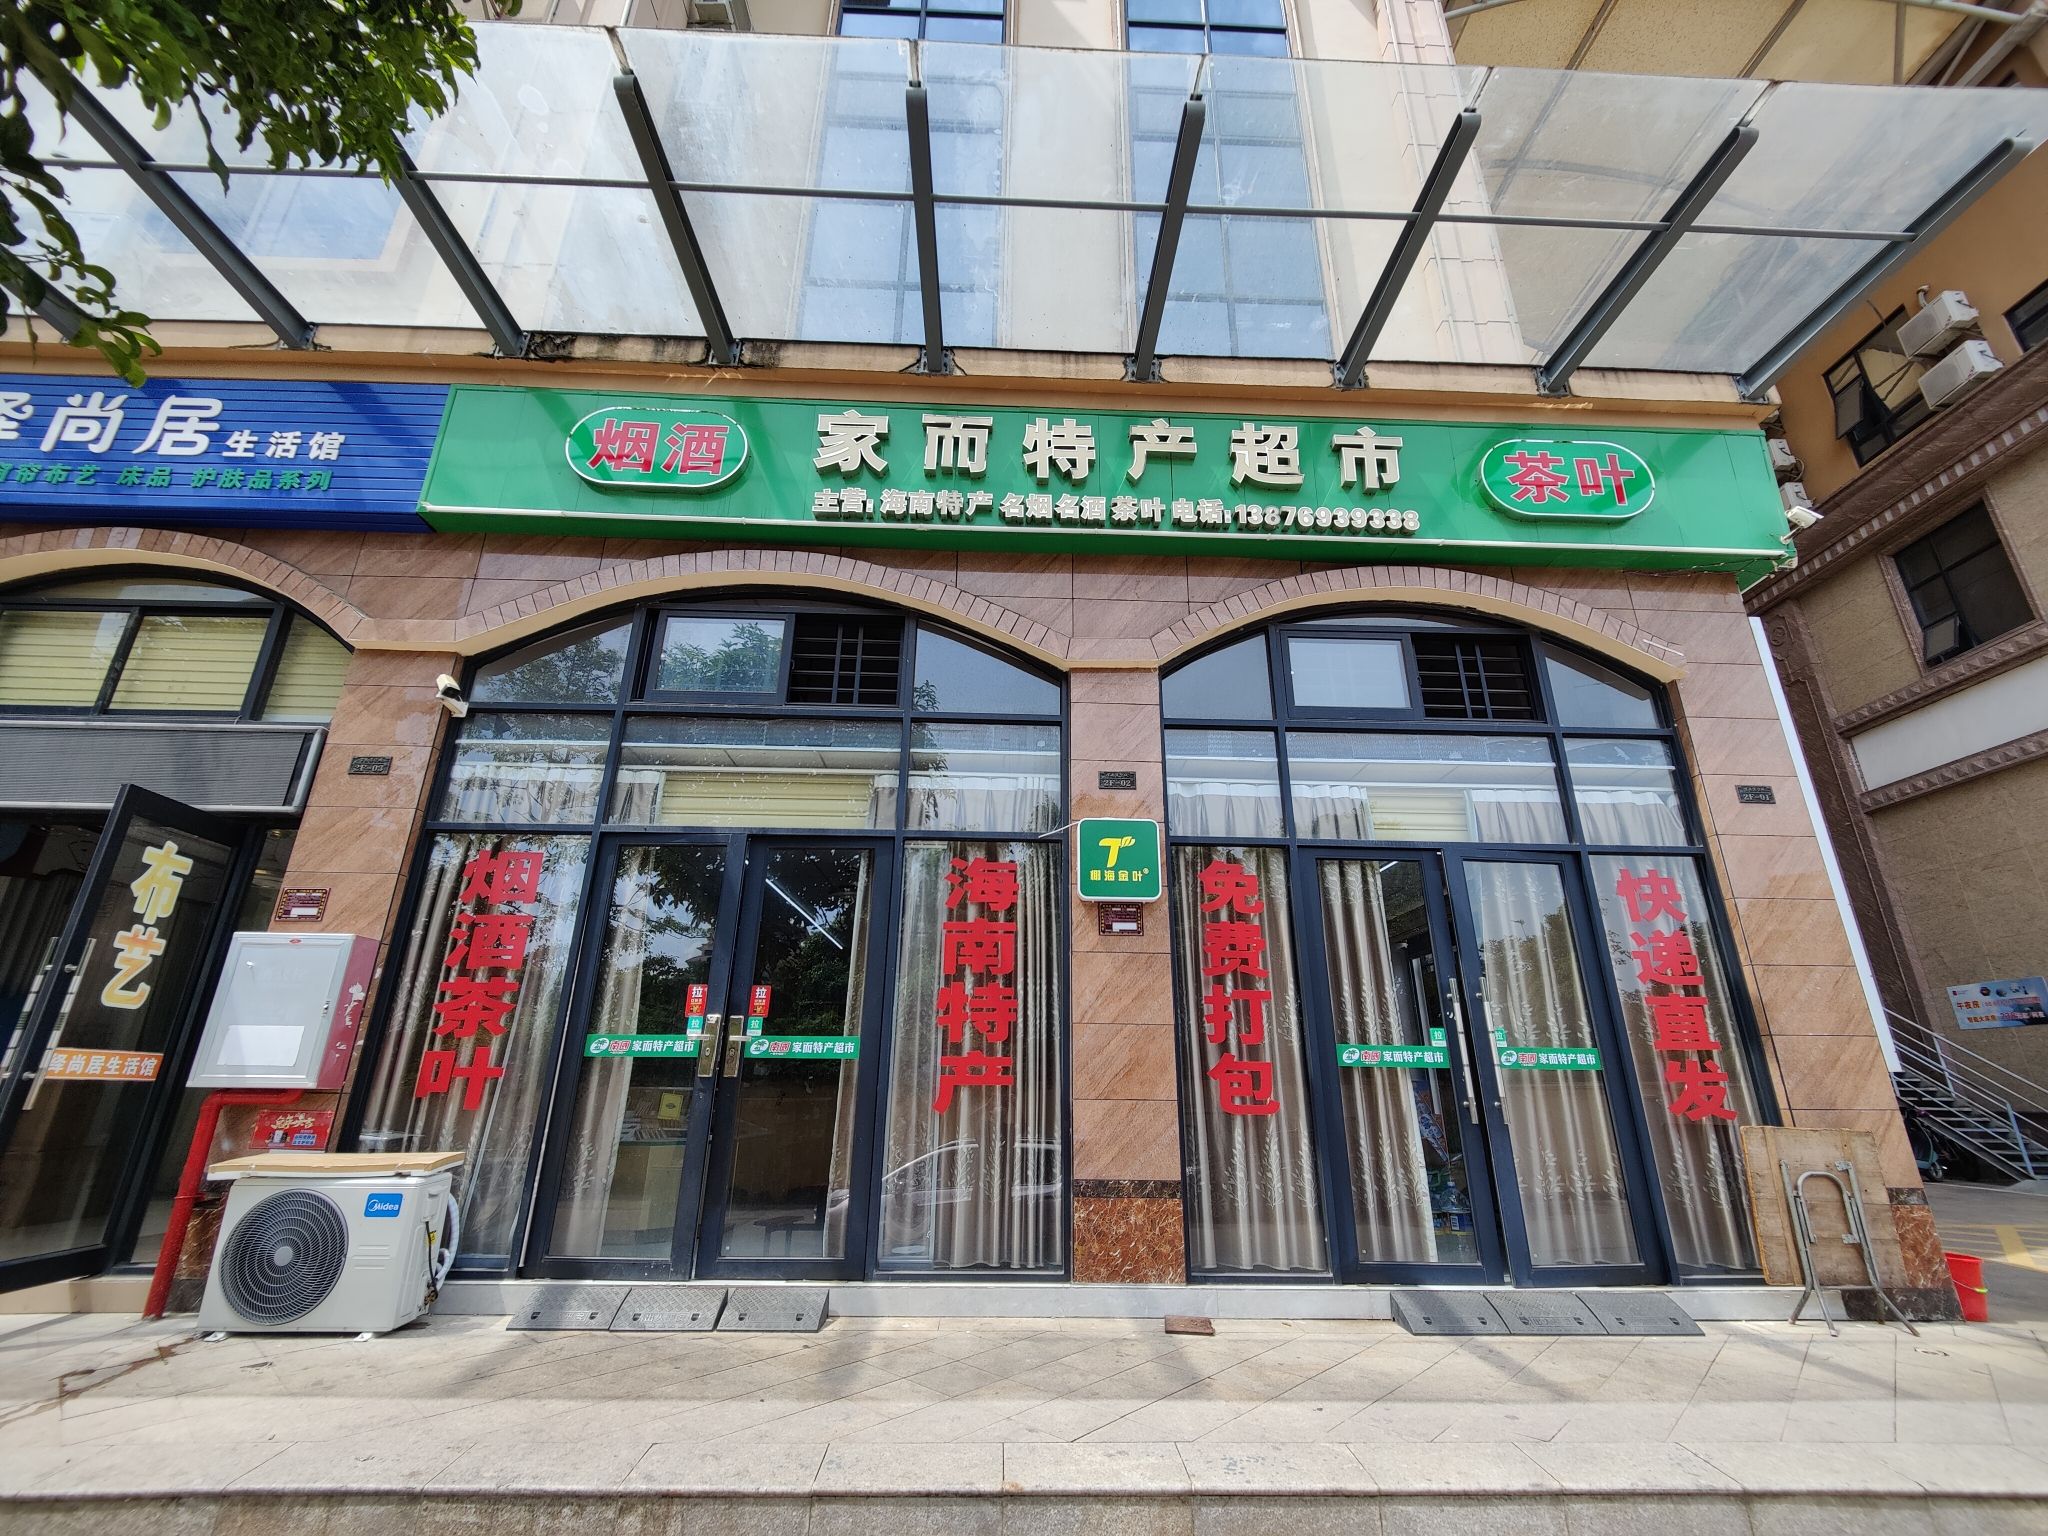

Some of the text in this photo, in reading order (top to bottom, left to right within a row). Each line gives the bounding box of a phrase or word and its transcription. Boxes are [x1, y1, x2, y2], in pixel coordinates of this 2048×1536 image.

[222, 430, 346, 461] 生活馆
[586, 417, 729, 476] 烟酒
[813, 409, 1404, 494] 家而特产超市
[116, 466, 173, 488] 床品
[191, 468, 333, 491] 护肤品系列
[1504, 450, 1636, 506] 茶叶
[1103, 779, 1131, 788] 2F-02
[101, 841, 193, 1009] 布艺
[415, 849, 545, 1111] 烟酒茶叶
[932, 857, 1019, 1115] 海南特产
[1198, 860, 1281, 1116] 免费打包
[692, 986, 703, 998] 拉
[755, 987, 767, 999] 拉
[1616, 869, 1738, 1121] 快递直发
[692, 1019, 700, 1028] 拉
[750, 1019, 759, 1029] 拉
[632, 1040, 695, 1053] 家而特产超市
[792, 1041, 855, 1054] 家而特产超市
[1382, 1051, 1444, 1063] 家而特产超市
[1538, 1053, 1596, 1065] 家而特产超市
[368, 1199, 399, 1212] Midea
